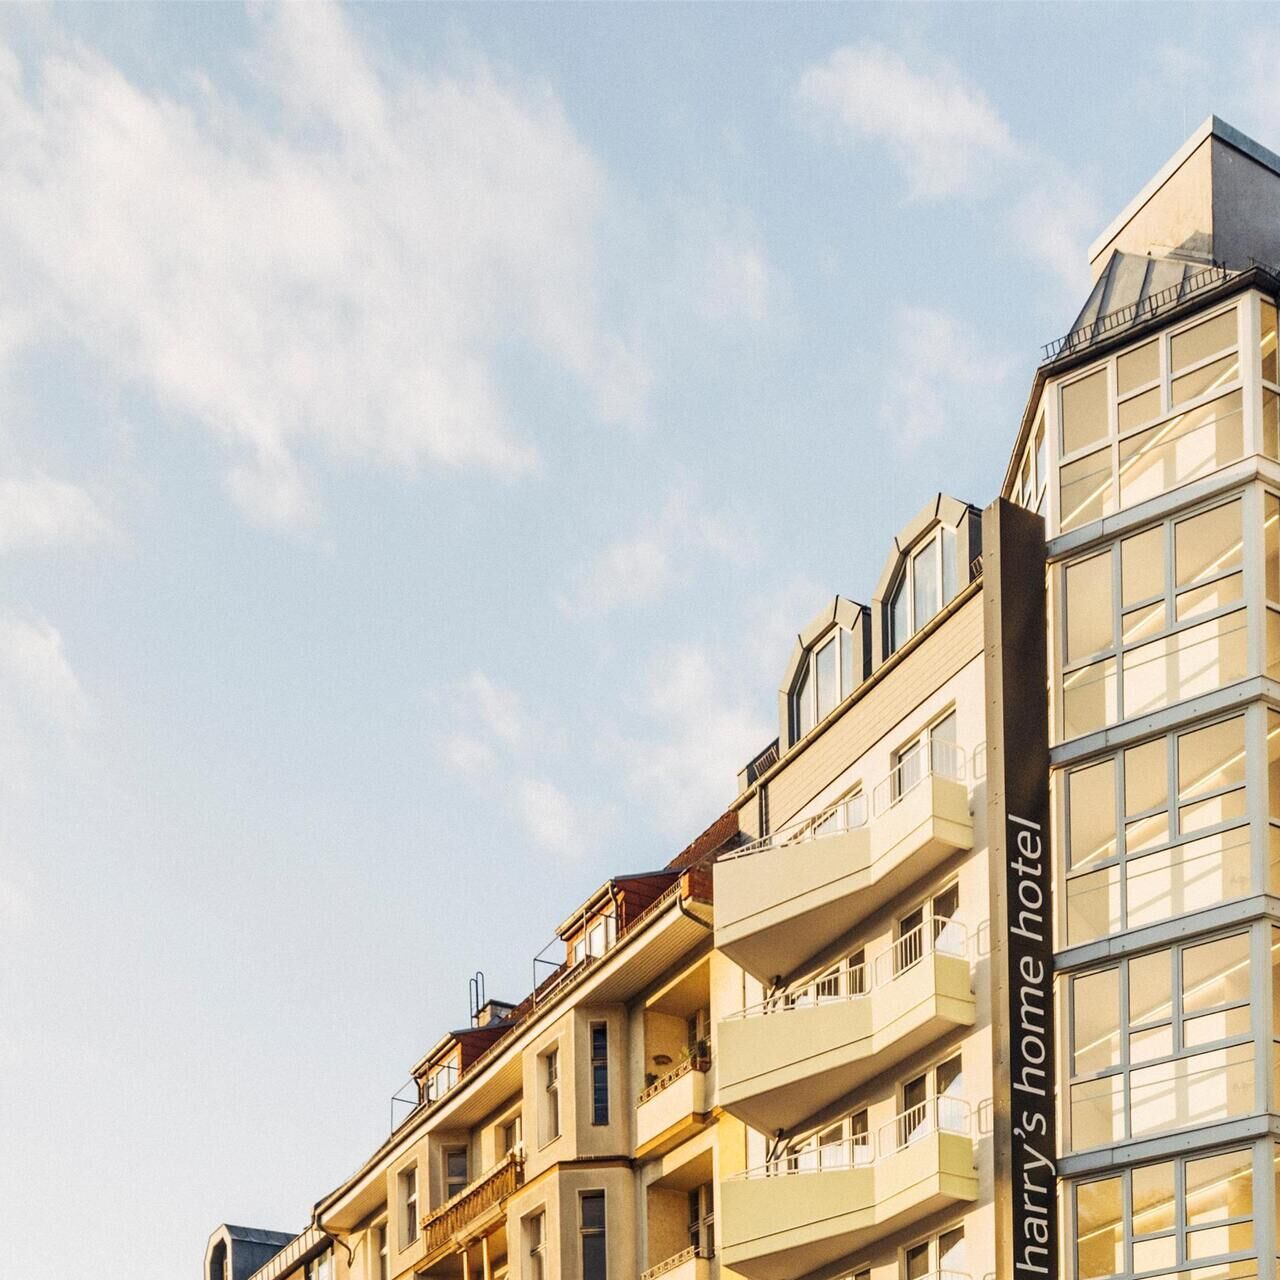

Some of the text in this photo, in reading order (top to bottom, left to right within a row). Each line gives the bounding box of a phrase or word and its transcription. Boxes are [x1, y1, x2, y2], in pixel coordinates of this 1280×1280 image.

[1008, 814, 1056, 1274] harry's home hotel
